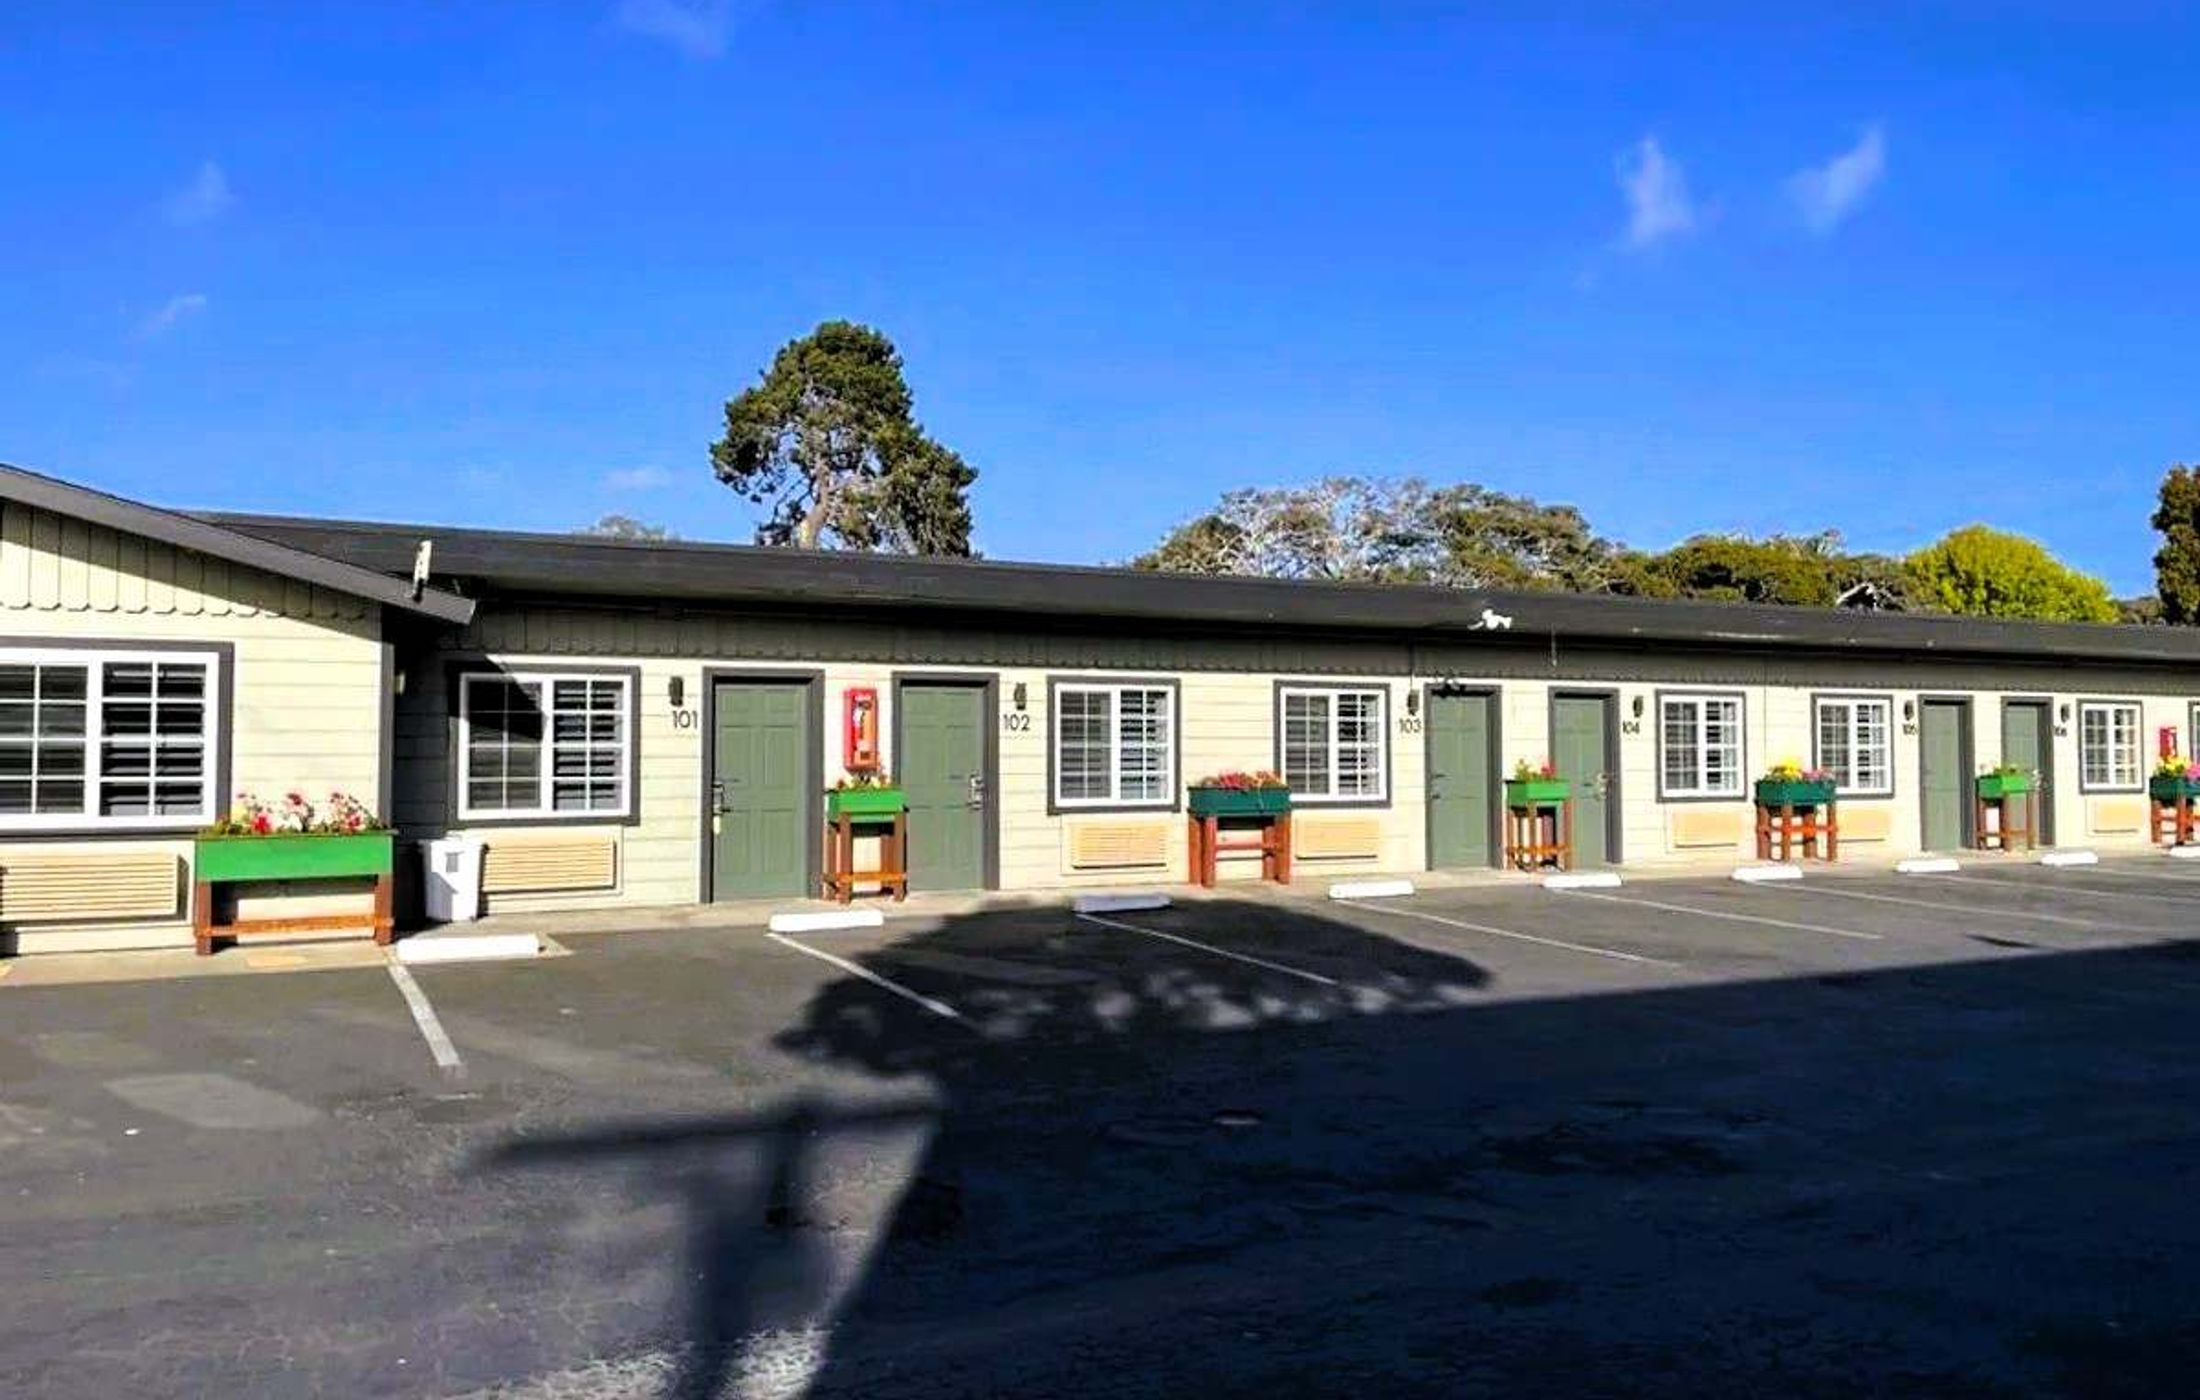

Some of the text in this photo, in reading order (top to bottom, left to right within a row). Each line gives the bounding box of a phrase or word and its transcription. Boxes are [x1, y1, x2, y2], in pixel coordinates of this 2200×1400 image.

[672, 710, 698, 729] 101
[1004, 714, 1030, 731] 102
[1399, 719, 1421, 733] 103
